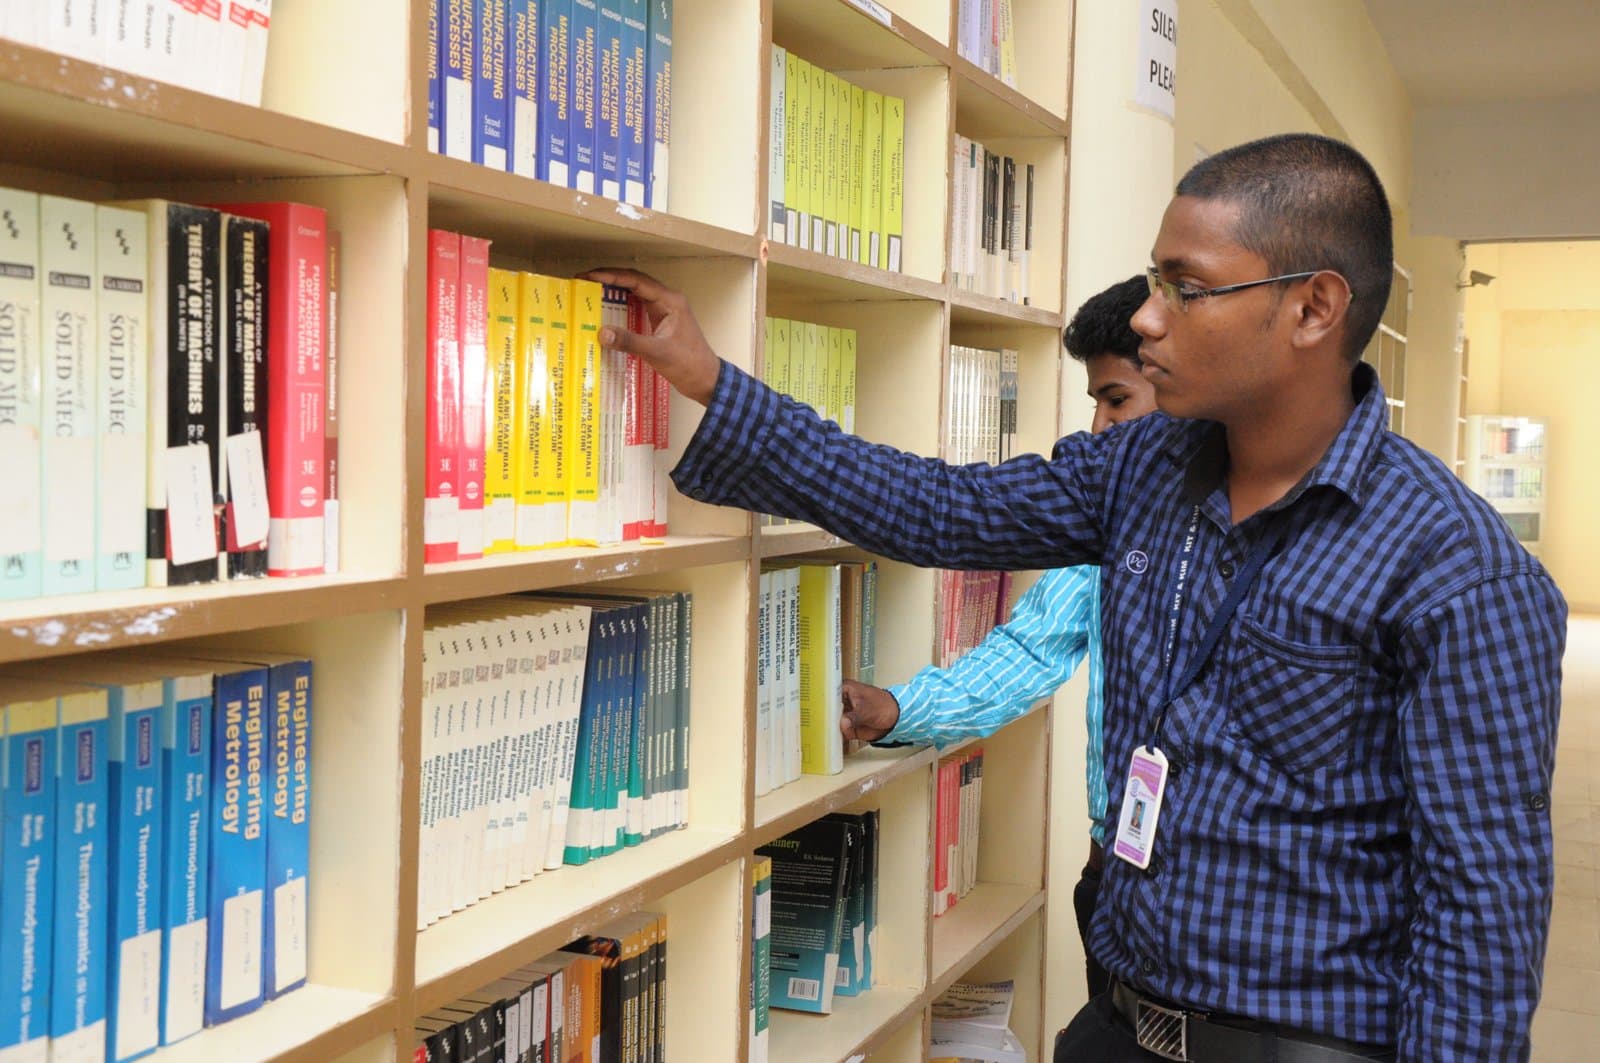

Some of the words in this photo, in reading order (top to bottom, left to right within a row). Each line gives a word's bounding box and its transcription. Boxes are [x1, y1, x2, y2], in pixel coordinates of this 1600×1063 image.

[493, 0, 504, 100] ANUFACTURING
[515, 12, 526, 91] PROCESSES
[527, 1, 537, 103] MANUFACTURIN
[549, 26, 558, 101] PROCESSES
[558, 15, 568, 120] MANUFACTURING
[575, 37, 585, 112] PROCESSES
[584, 26, 594, 129] MANUFACTURING
[601, 48, 611, 120] PROCESSES
[1149, 58, 1176, 97] PLEA
[610, 37, 620, 138] MANUFACTURING
[625, 57, 634, 128] PROCESSES
[634, 46, 644, 144] MANUFACTURING
[655, 72, 664, 139] PROCESSES
[662, 61, 671, 144] MANUFACTURIN
[188, 223, 203, 295] THEORY
[204, 278, 212, 286] A
[243, 230, 255, 296] THEORY
[255, 282, 262, 290] A
[305, 277, 313, 296] OF
[188, 295, 203, 321] OF
[204, 288, 213, 348] TEXTBOOK
[243, 298, 255, 322] OF
[297, 258, 306, 375] MANUFACTURING
[305, 297, 313, 357] MODERN
[56, 311, 73, 380] SOLID
[109, 313, 125, 380] SOLID
[188, 321, 203, 414] MACHINES
[204, 349, 213, 363] OF
[243, 322, 255, 413] MACHINES
[255, 350, 262, 364] OF
[503, 336, 511, 394] PROCESSES
[0, 384, 17, 424] MEC
[56, 387, 73, 437] MEC
[109, 387, 125, 434] MEC
[502, 423, 510, 480] MATERIALS
[585, 424, 593, 478] MATERIALS
[863, 625, 871, 665] Design
[221, 700, 242, 835] Metrology
[243, 684, 264, 841] Engineering
[273, 690, 291, 819] Metrology
[291, 675, 309, 826] Engineering
[136, 824, 150, 935] Thermodynami
[185, 810, 200, 923] Thermodynamic
[20, 855, 40, 993] Thermodynamics
[75, 841, 93, 974] Thermodynamics
